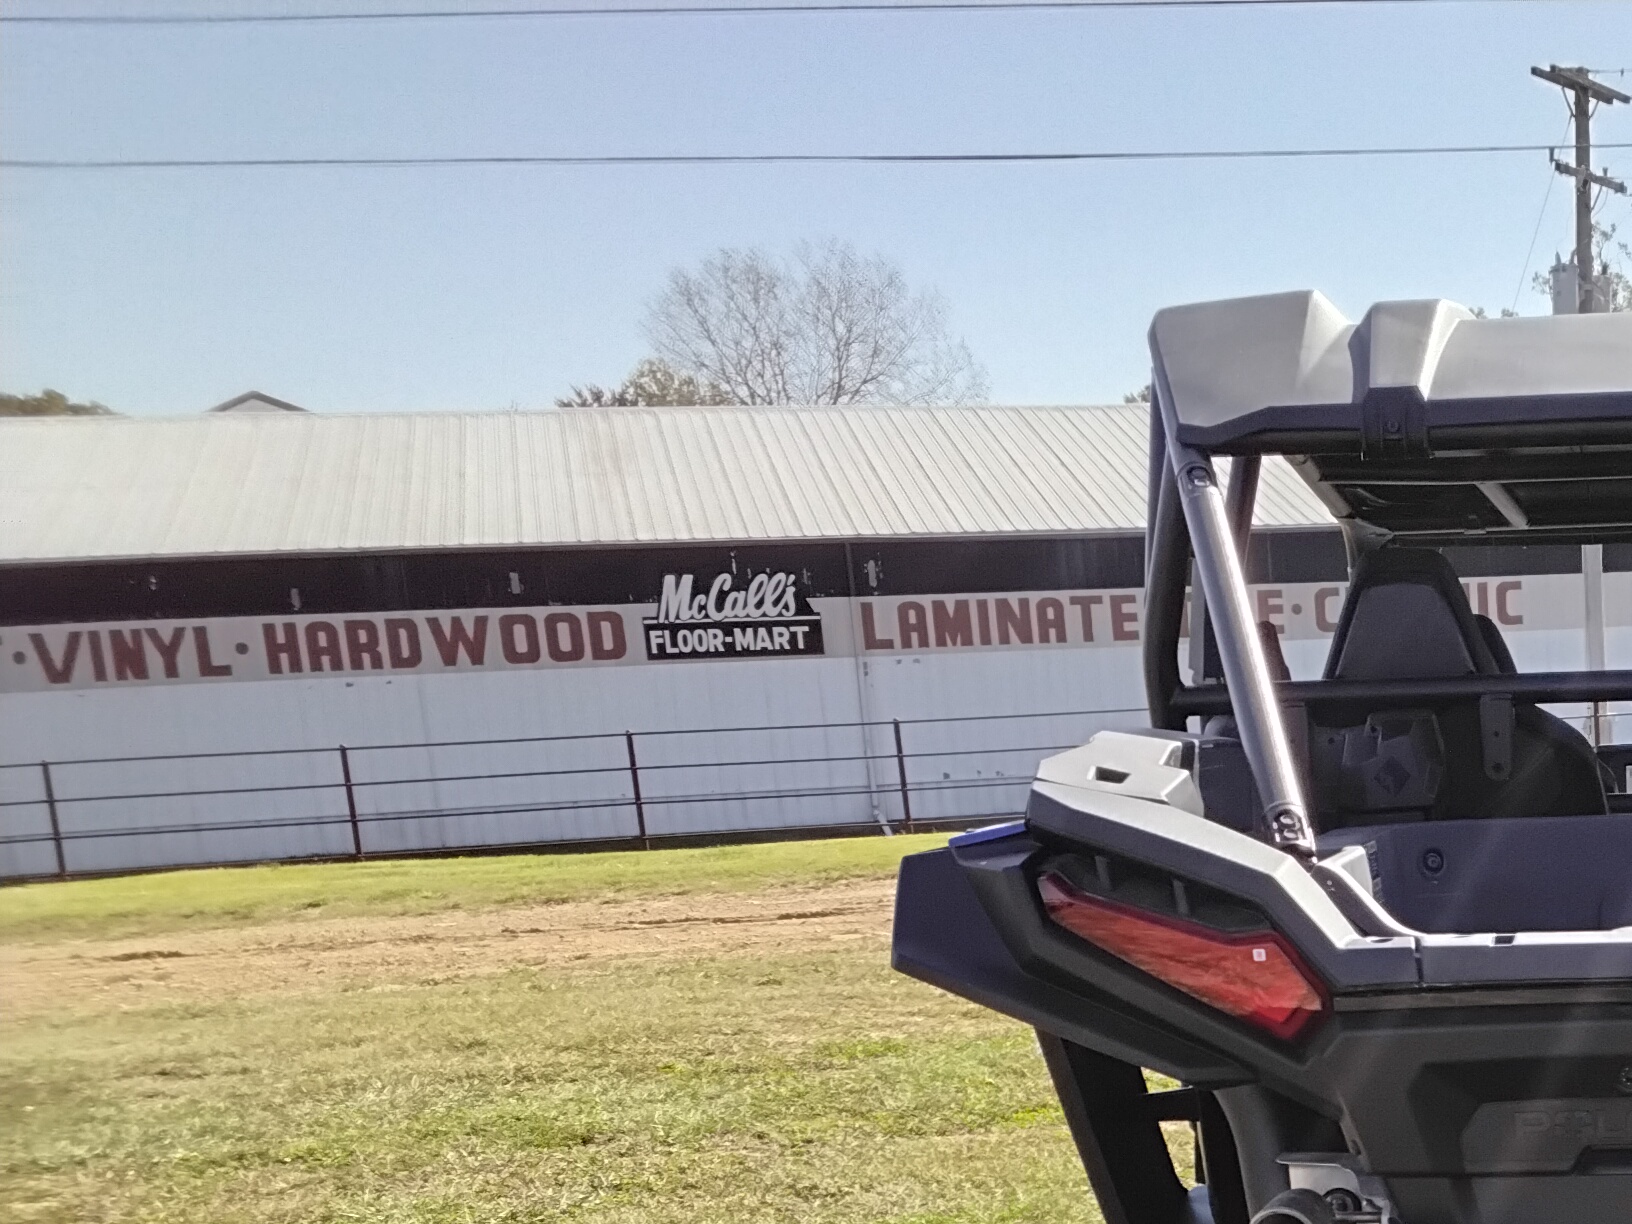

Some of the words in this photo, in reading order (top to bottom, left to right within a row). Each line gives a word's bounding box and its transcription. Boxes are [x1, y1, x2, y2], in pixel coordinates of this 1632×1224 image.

[658, 572, 796, 623] McCall's
[860, 594, 1140, 650] LAMINATE
[28, 626, 233, 684] VINYL
[261, 611, 627, 674] HARDWOOD
[649, 626, 809, 654] FLOOR-MART
